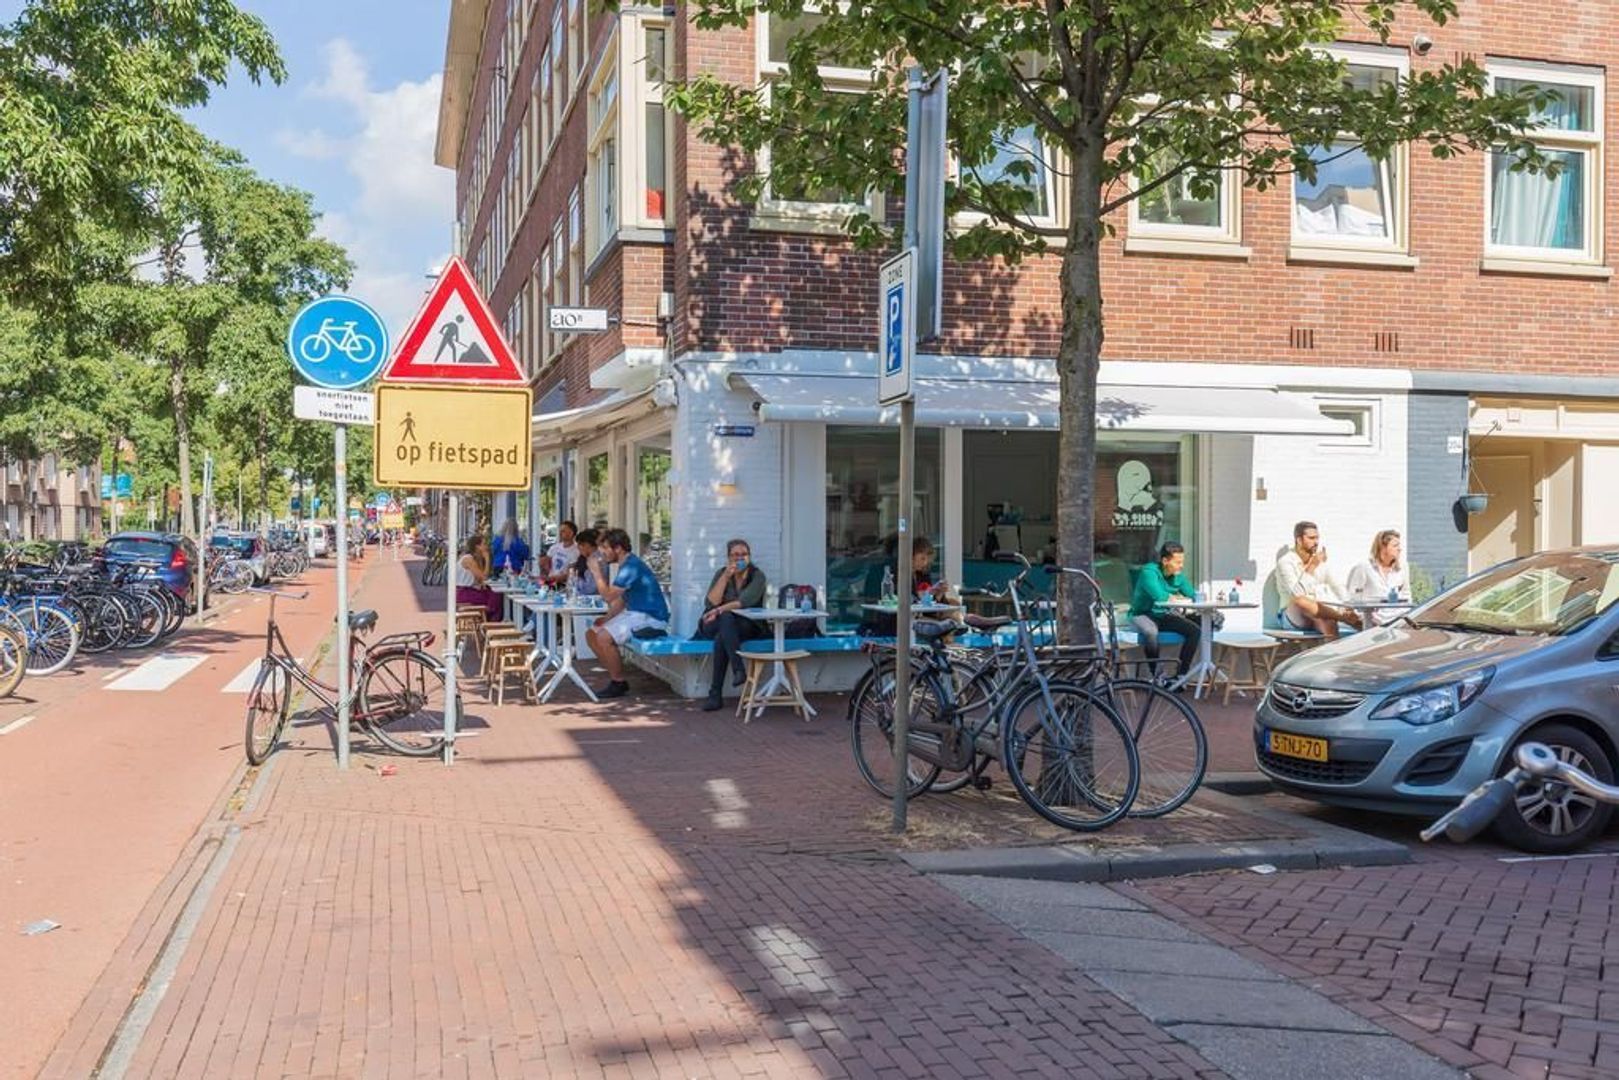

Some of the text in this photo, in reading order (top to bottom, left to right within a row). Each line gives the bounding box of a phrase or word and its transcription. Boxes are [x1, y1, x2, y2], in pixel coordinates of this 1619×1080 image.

[889, 295, 900, 338] P
[319, 410, 369, 421] toegestaan
[335, 402, 353, 410] niet
[396, 441, 518, 468] op fietspad
[1273, 734, 1322, 758] 5-TNJ-70
